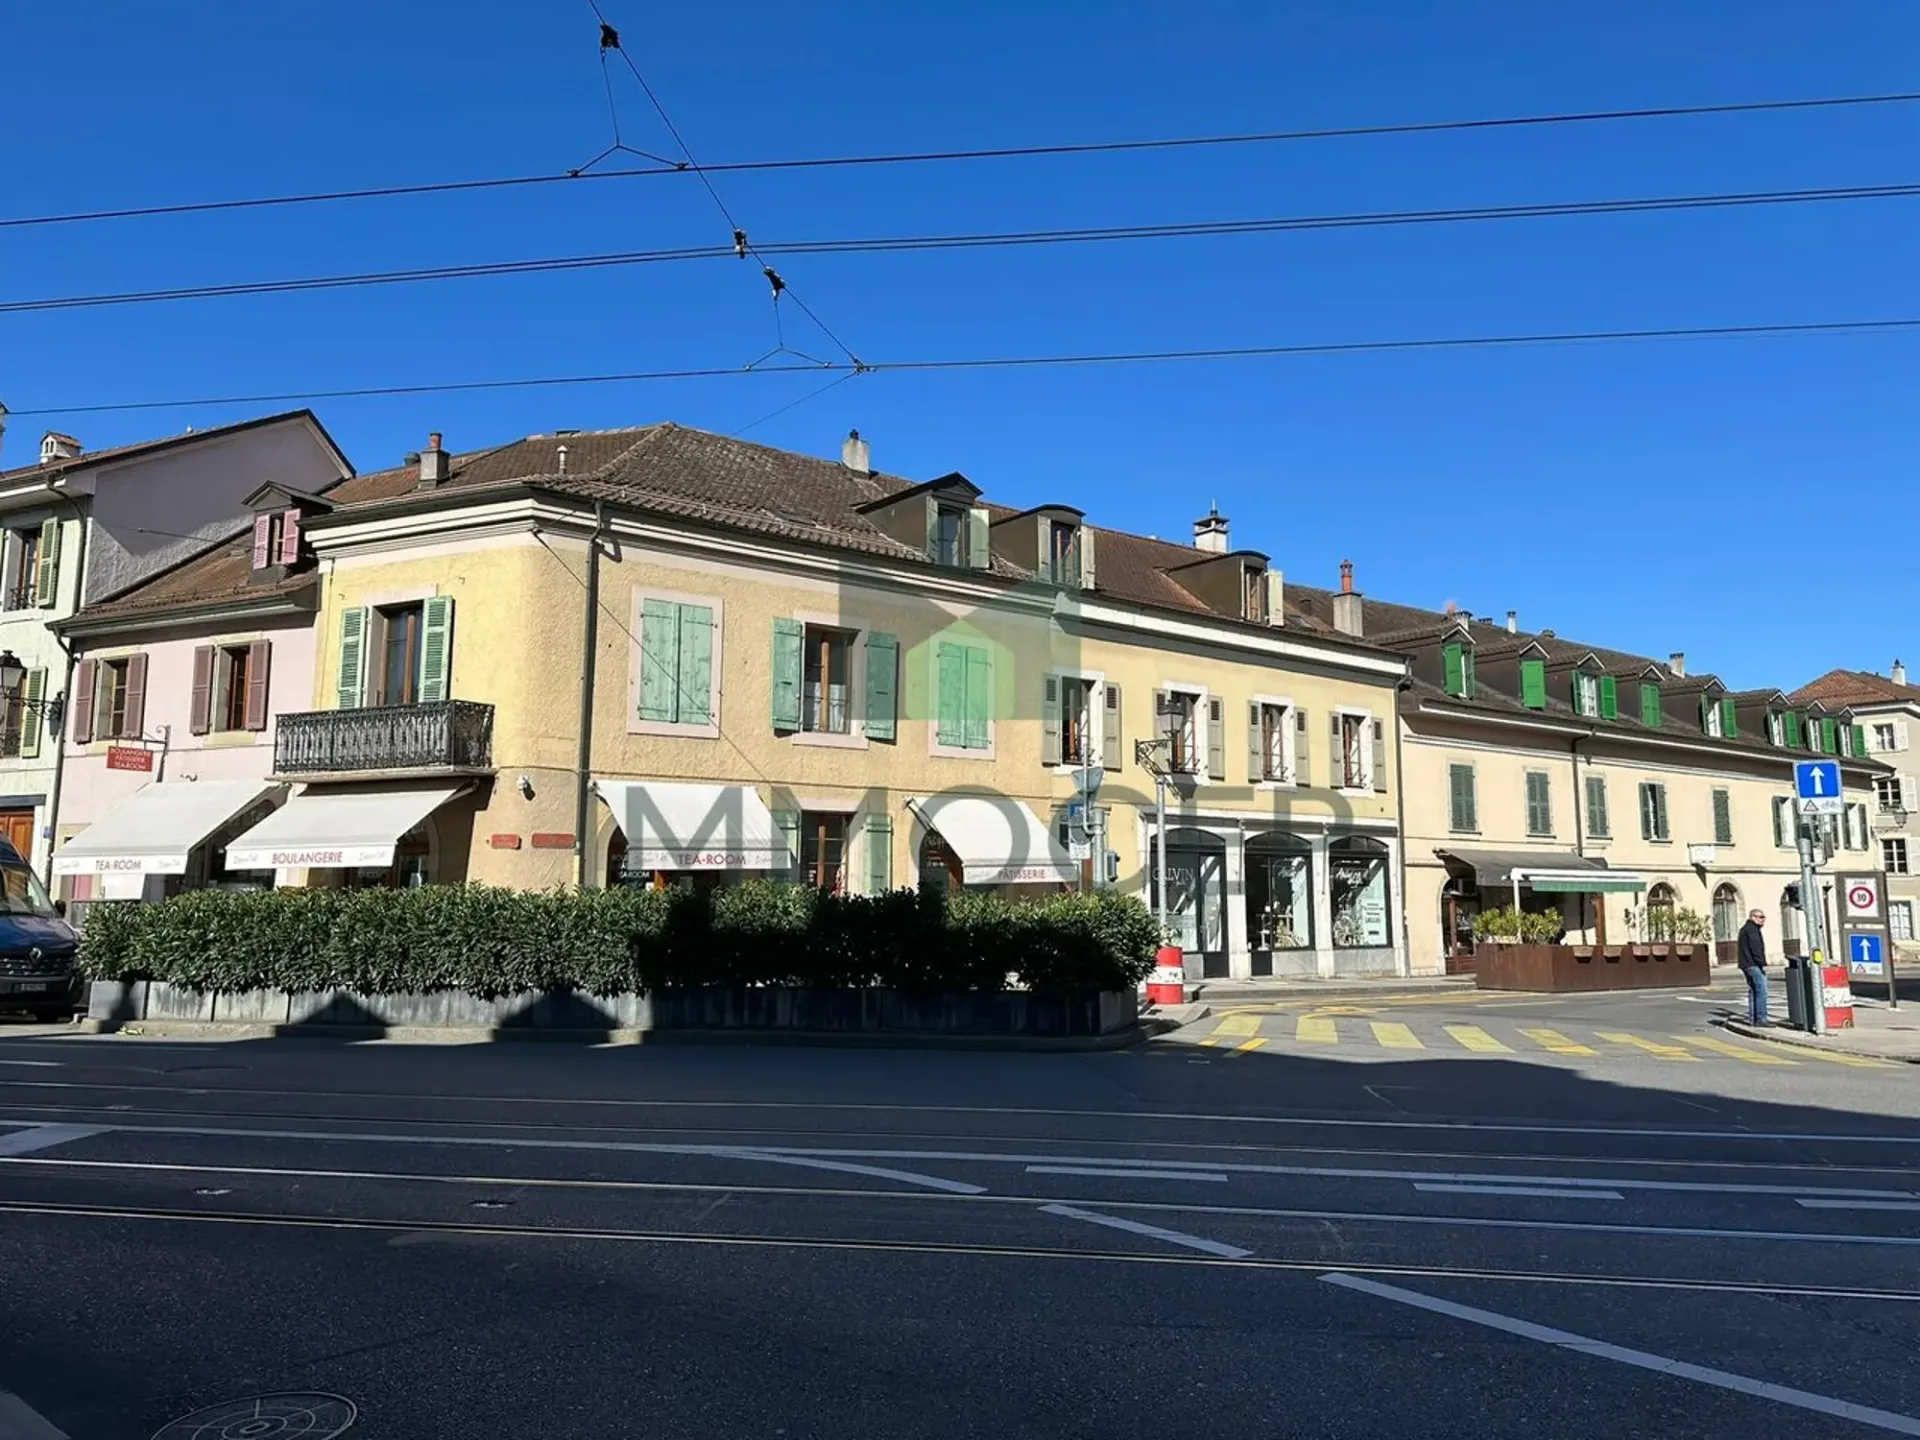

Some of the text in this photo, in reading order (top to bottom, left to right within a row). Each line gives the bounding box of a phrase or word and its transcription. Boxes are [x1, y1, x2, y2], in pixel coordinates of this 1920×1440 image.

[271, 851, 343, 865] BOULANGERIE
[678, 854, 747, 866] TEA-ROOM
[95, 859, 142, 871] TEA-ROOM
[1856, 892, 1867, 903] 30
